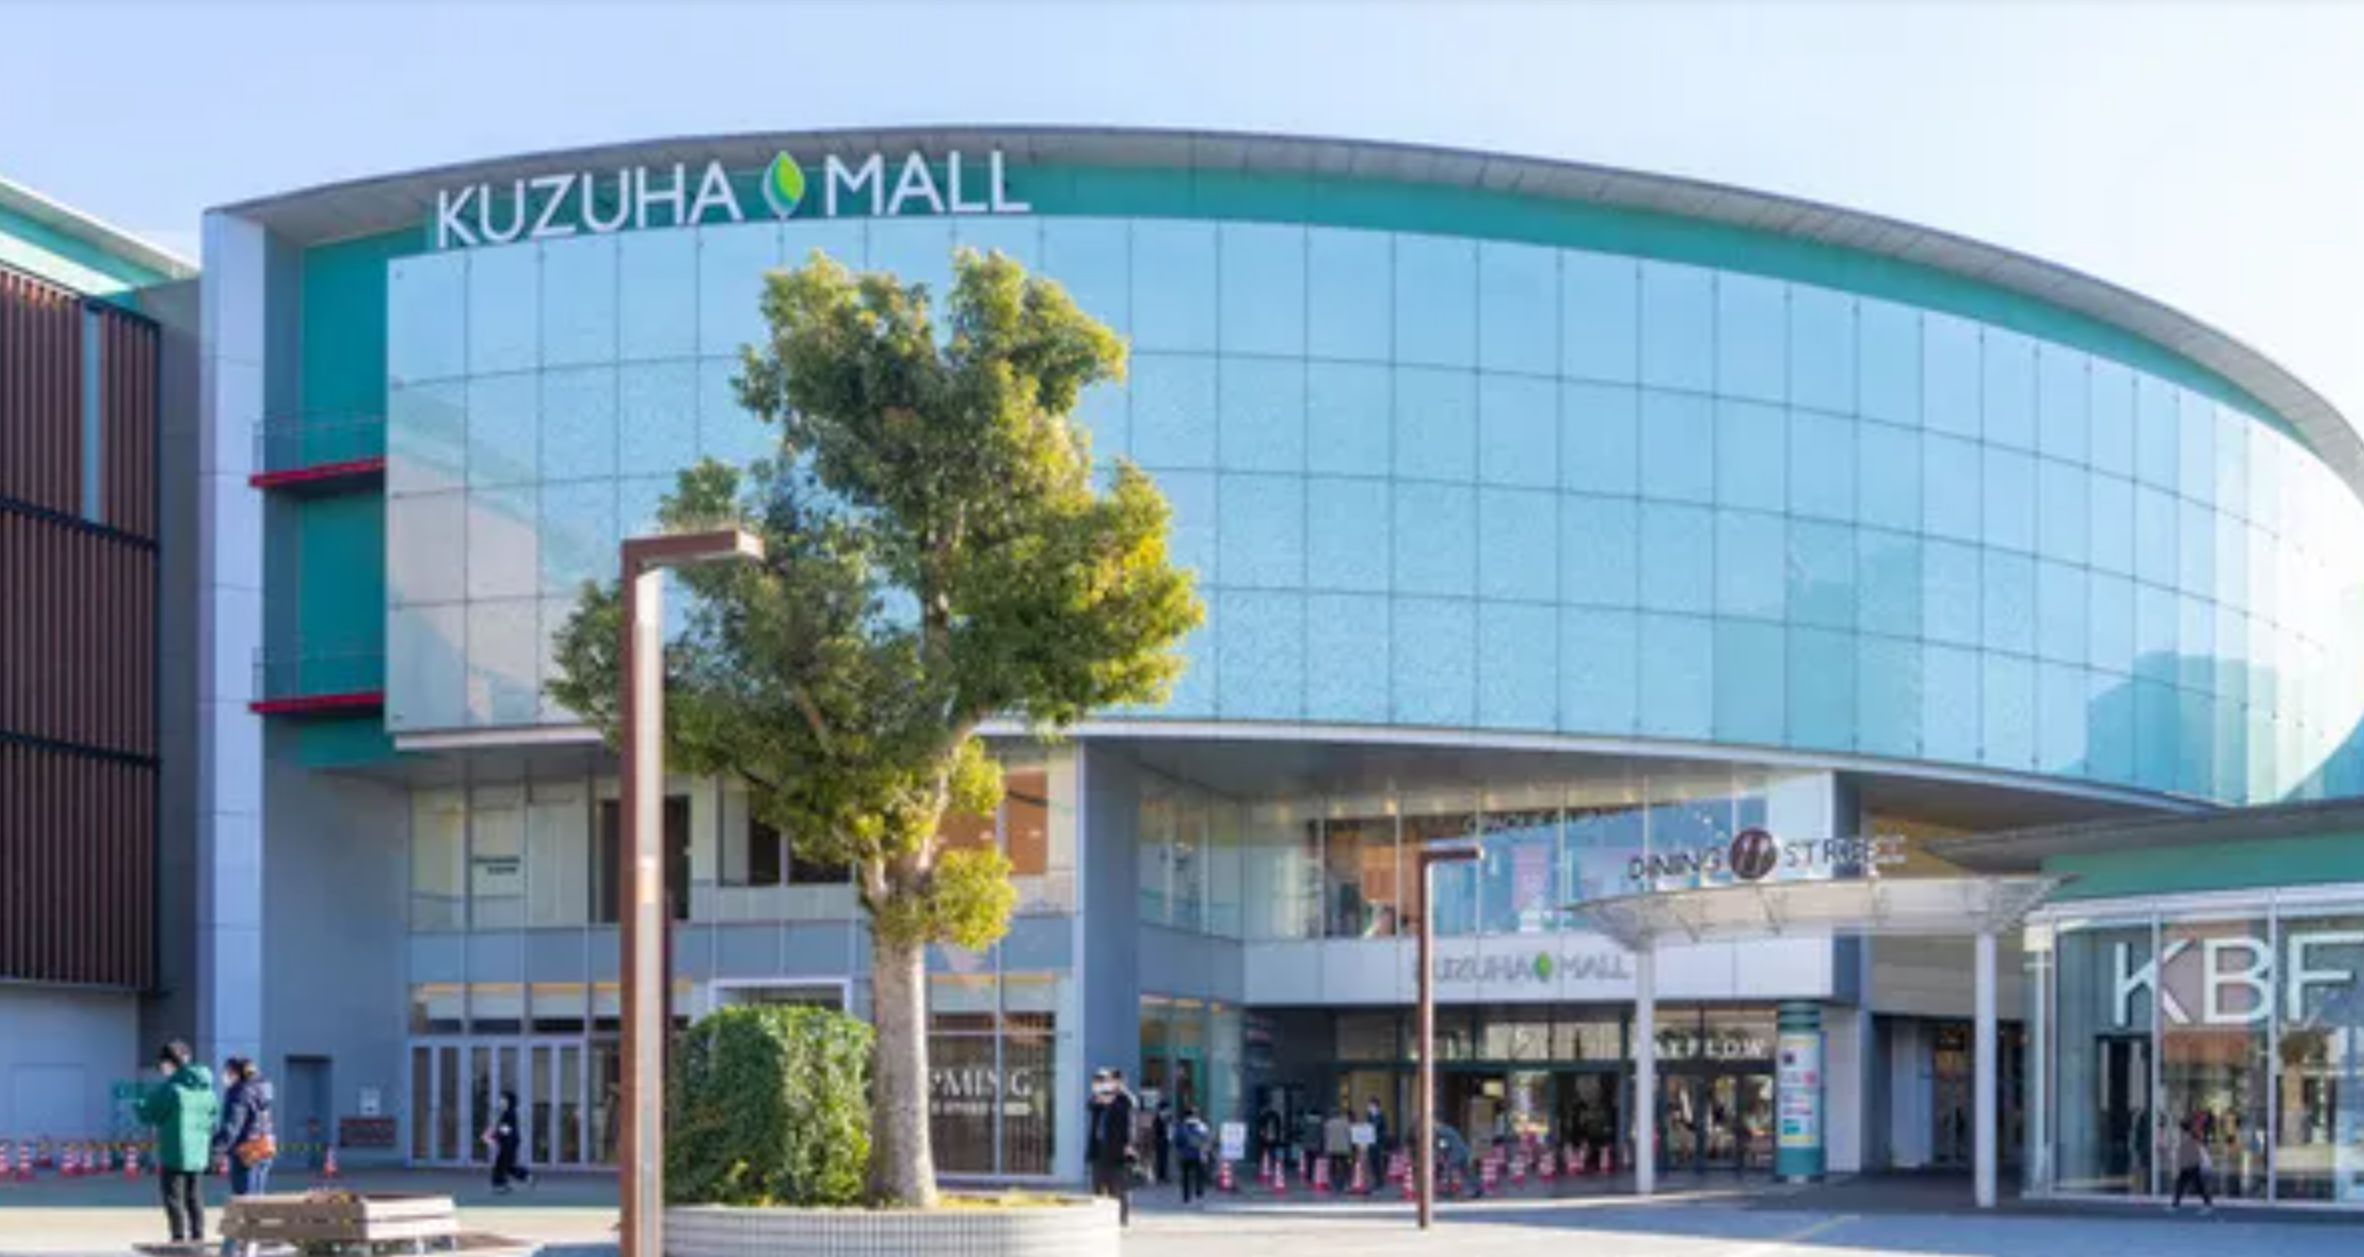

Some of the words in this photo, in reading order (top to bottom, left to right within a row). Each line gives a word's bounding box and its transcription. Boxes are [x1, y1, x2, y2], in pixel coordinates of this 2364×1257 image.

[436, 160, 744, 249] KUZUHA
[825, 150, 1032, 217] MALL
[1559, 953, 1631, 981] MALL
[2113, 930, 2364, 1028] KBF
